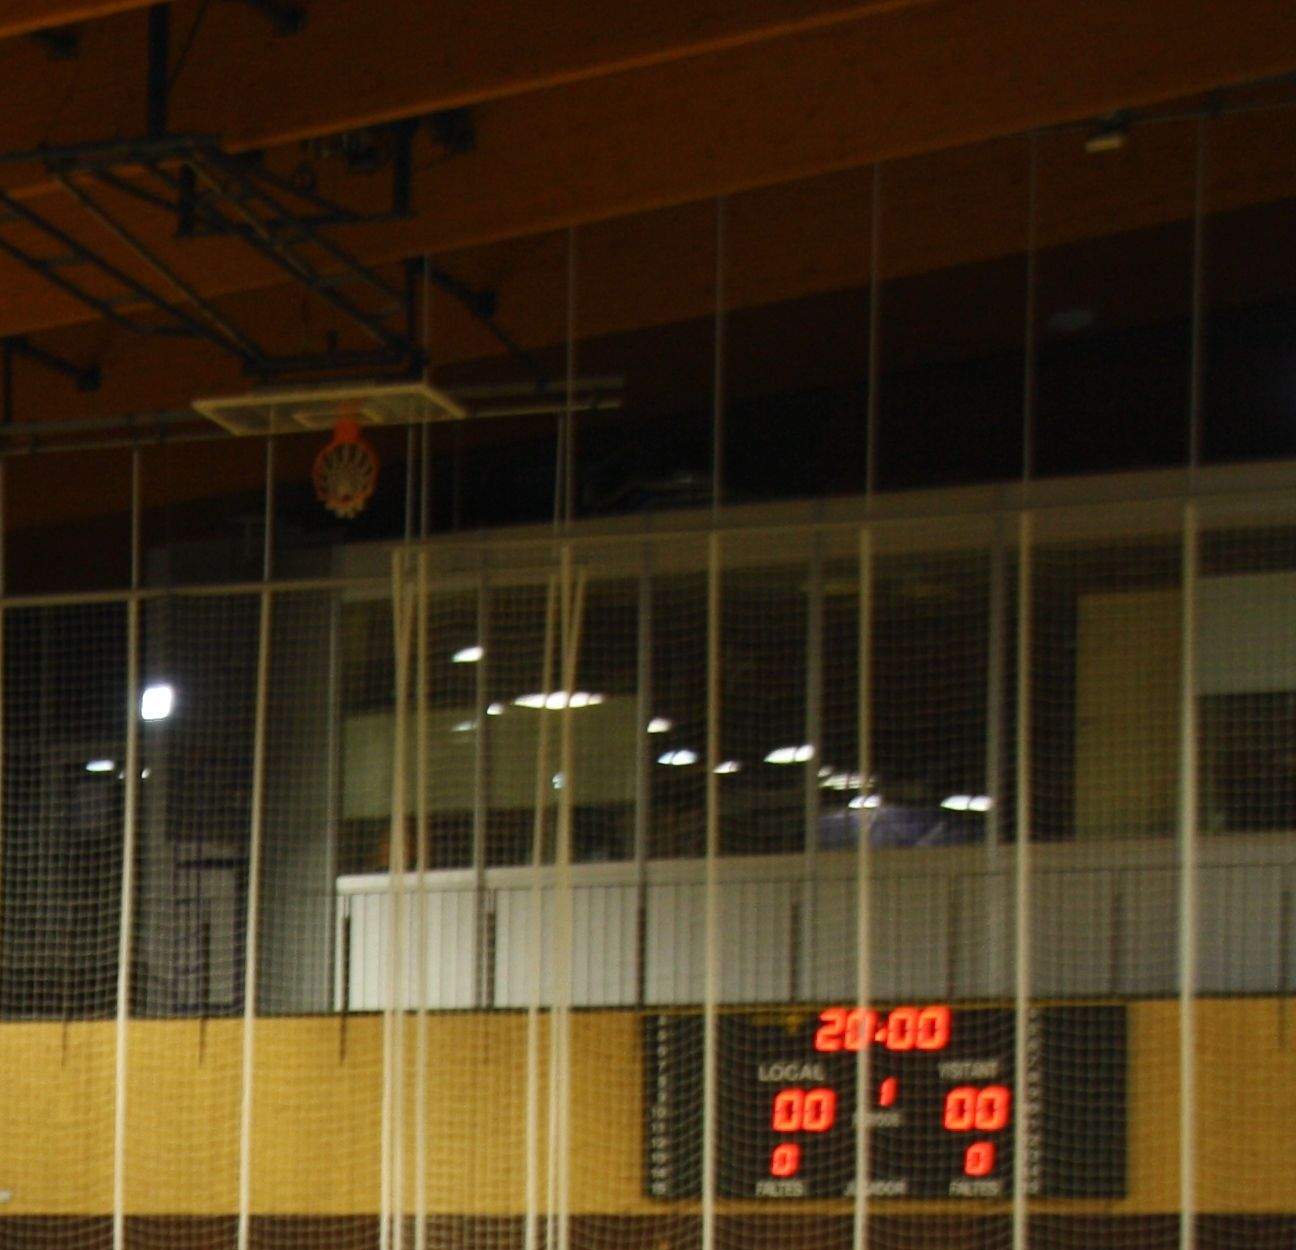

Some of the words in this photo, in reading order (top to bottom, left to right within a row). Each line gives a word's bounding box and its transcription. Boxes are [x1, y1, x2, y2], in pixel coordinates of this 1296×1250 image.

[813, 1006, 952, 1051] 20:00
[757, 1062, 825, 1082] LOCAL
[773, 1087, 836, 1132] 00
[943, 1085, 1010, 1130] 00
[770, 1142, 801, 1177] 0
[964, 1140, 996, 1176] 0
